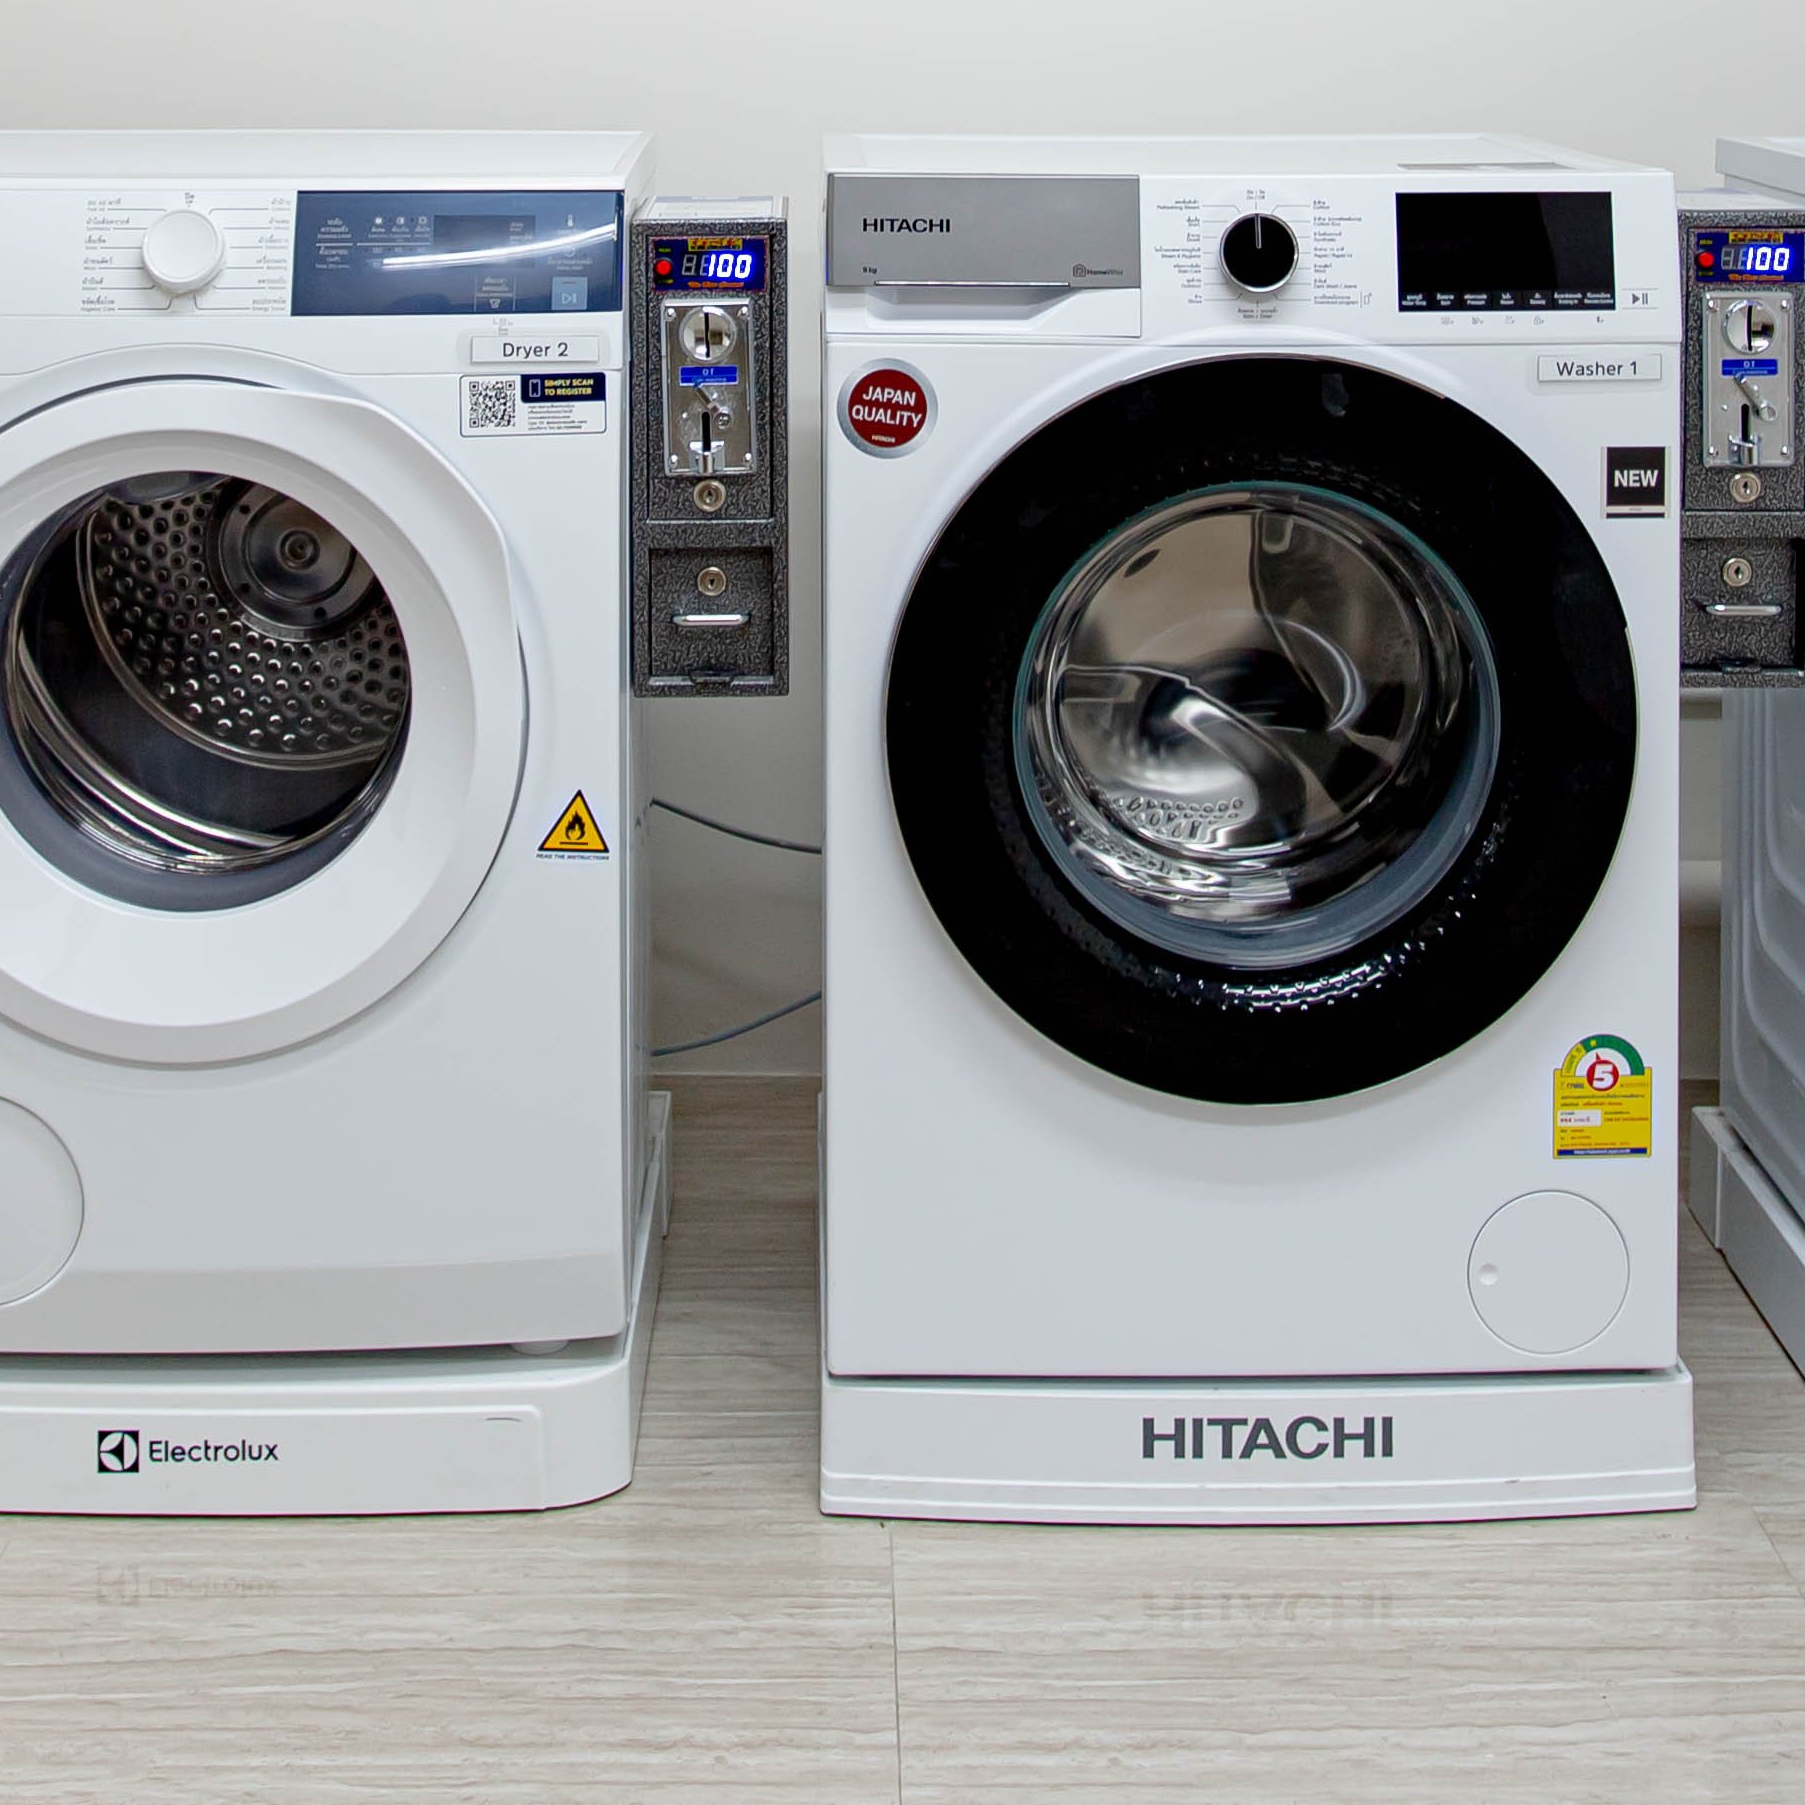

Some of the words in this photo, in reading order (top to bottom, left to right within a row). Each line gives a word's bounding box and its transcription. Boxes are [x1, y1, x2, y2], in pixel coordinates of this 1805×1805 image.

[862, 218, 951, 233] HITACHI
[708, 253, 753, 279] 100
[1746, 246, 1790, 271] 100
[503, 342, 551, 359] Dryer
[557, 342, 569, 357] 2
[1556, 360, 1623, 376] Washer
[1630, 360, 1638, 375] 1
[544, 379, 571, 387] SIMPLY
[572, 378, 594, 386] SCAN
[544, 388, 555, 396] TO
[557, 387, 592, 396] REGISTER
[862, 385, 916, 407] JAPAN
[851, 403, 923, 428] QUALITY
[1614, 469, 1659, 488] NEW
[1593, 1063, 1614, 1089] 5
[1142, 1416, 1394, 1460] HITACHI
[148, 1440, 279, 1462] Electrolux
